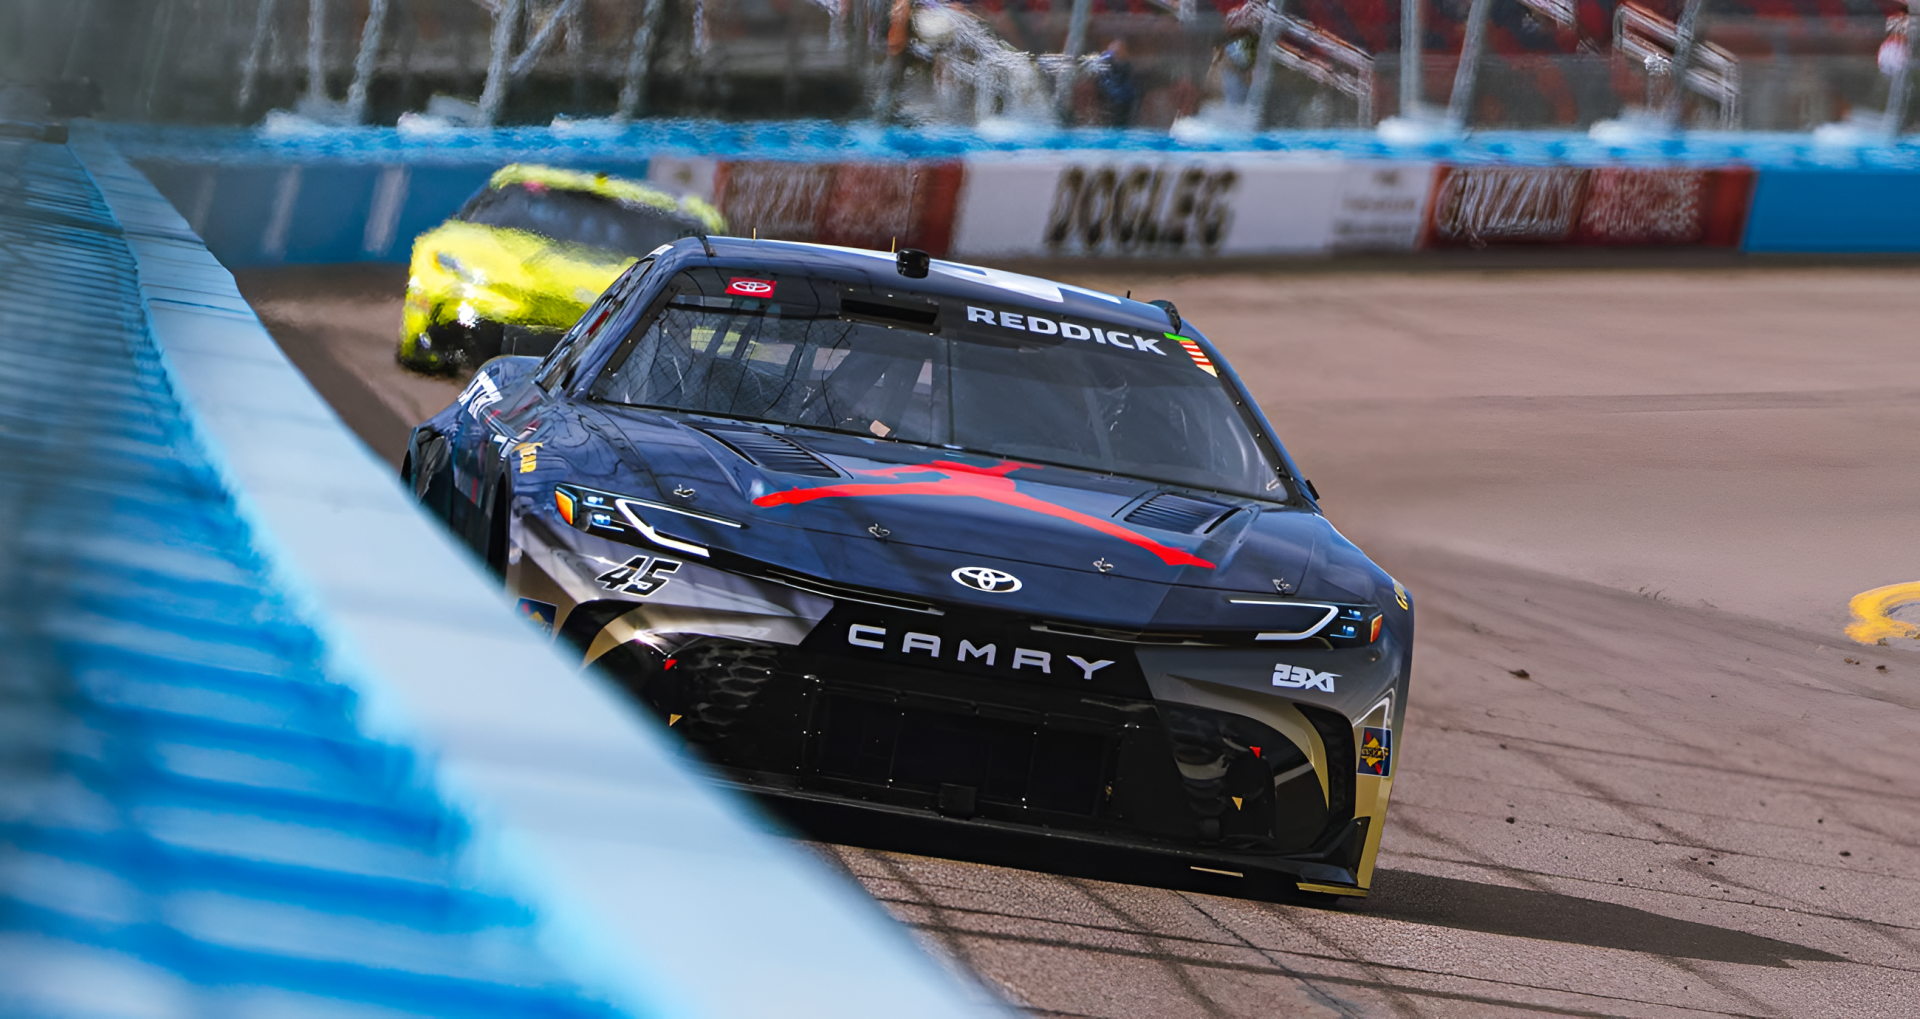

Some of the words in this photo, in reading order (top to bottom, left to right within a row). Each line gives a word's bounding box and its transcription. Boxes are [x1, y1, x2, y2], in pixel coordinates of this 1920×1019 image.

[1044, 163, 1238, 246] DOGLEG
[967, 306, 1167, 356] REDDICK
[595, 555, 682, 597] 45
[847, 623, 1115, 680] CAMRY
